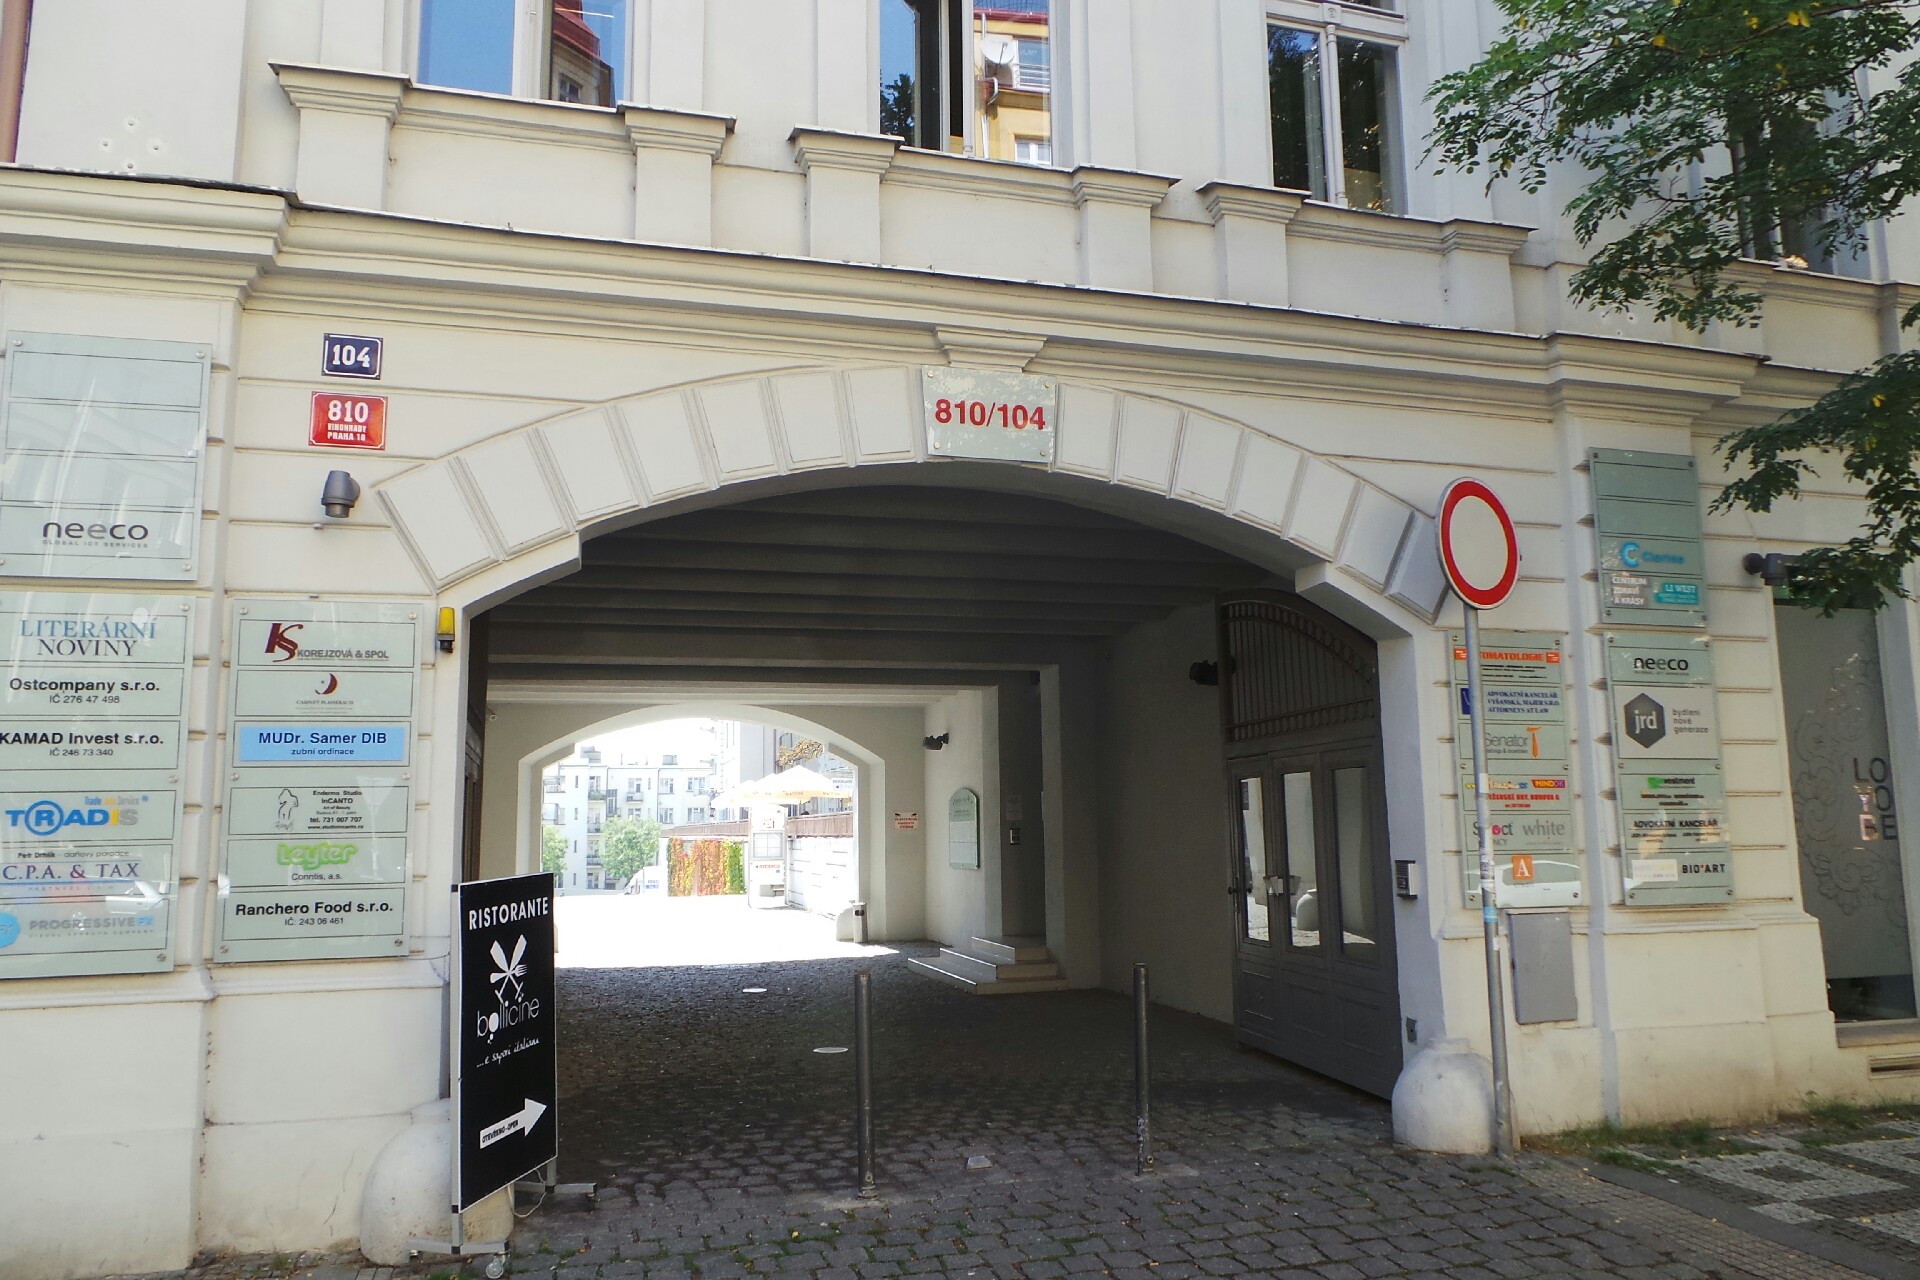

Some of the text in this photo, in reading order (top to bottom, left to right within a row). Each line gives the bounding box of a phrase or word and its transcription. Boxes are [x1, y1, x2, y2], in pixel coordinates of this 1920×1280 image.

[332, 344, 370, 367] 104
[328, 400, 369, 423] 810
[935, 399, 1046, 430] 810/104
[327, 423, 367, 433] VINOHRADY
[327, 432, 366, 441] PRAHA 10
[42, 521, 149, 540] neeco
[19, 616, 158, 639] LITERÁRNÍ
[37, 638, 138, 657] NOVINY
[355, 650, 363, 658] &
[1633, 656, 1689, 671] neeco
[9, 677, 160, 694] Ostcompany s.r.o.
[63, 695, 82, 704] 276
[85, 695, 99, 704] 47
[101, 695, 120, 704] 498
[1634, 709, 1658, 734] jrd
[0, 732, 164, 745] KAMAD Invest s.r.o.
[258, 732, 387, 744] MUDr. Samer DIB
[318, 747, 354, 755] ordinace
[1522, 819, 1566, 836] white
[70, 864, 86, 879] &
[96, 863, 140, 878] TAX
[1516, 859, 1531, 877] A
[235, 901, 393, 916] Ranchero Food s.r.o.
[469, 896, 549, 930] RISTORANTE
